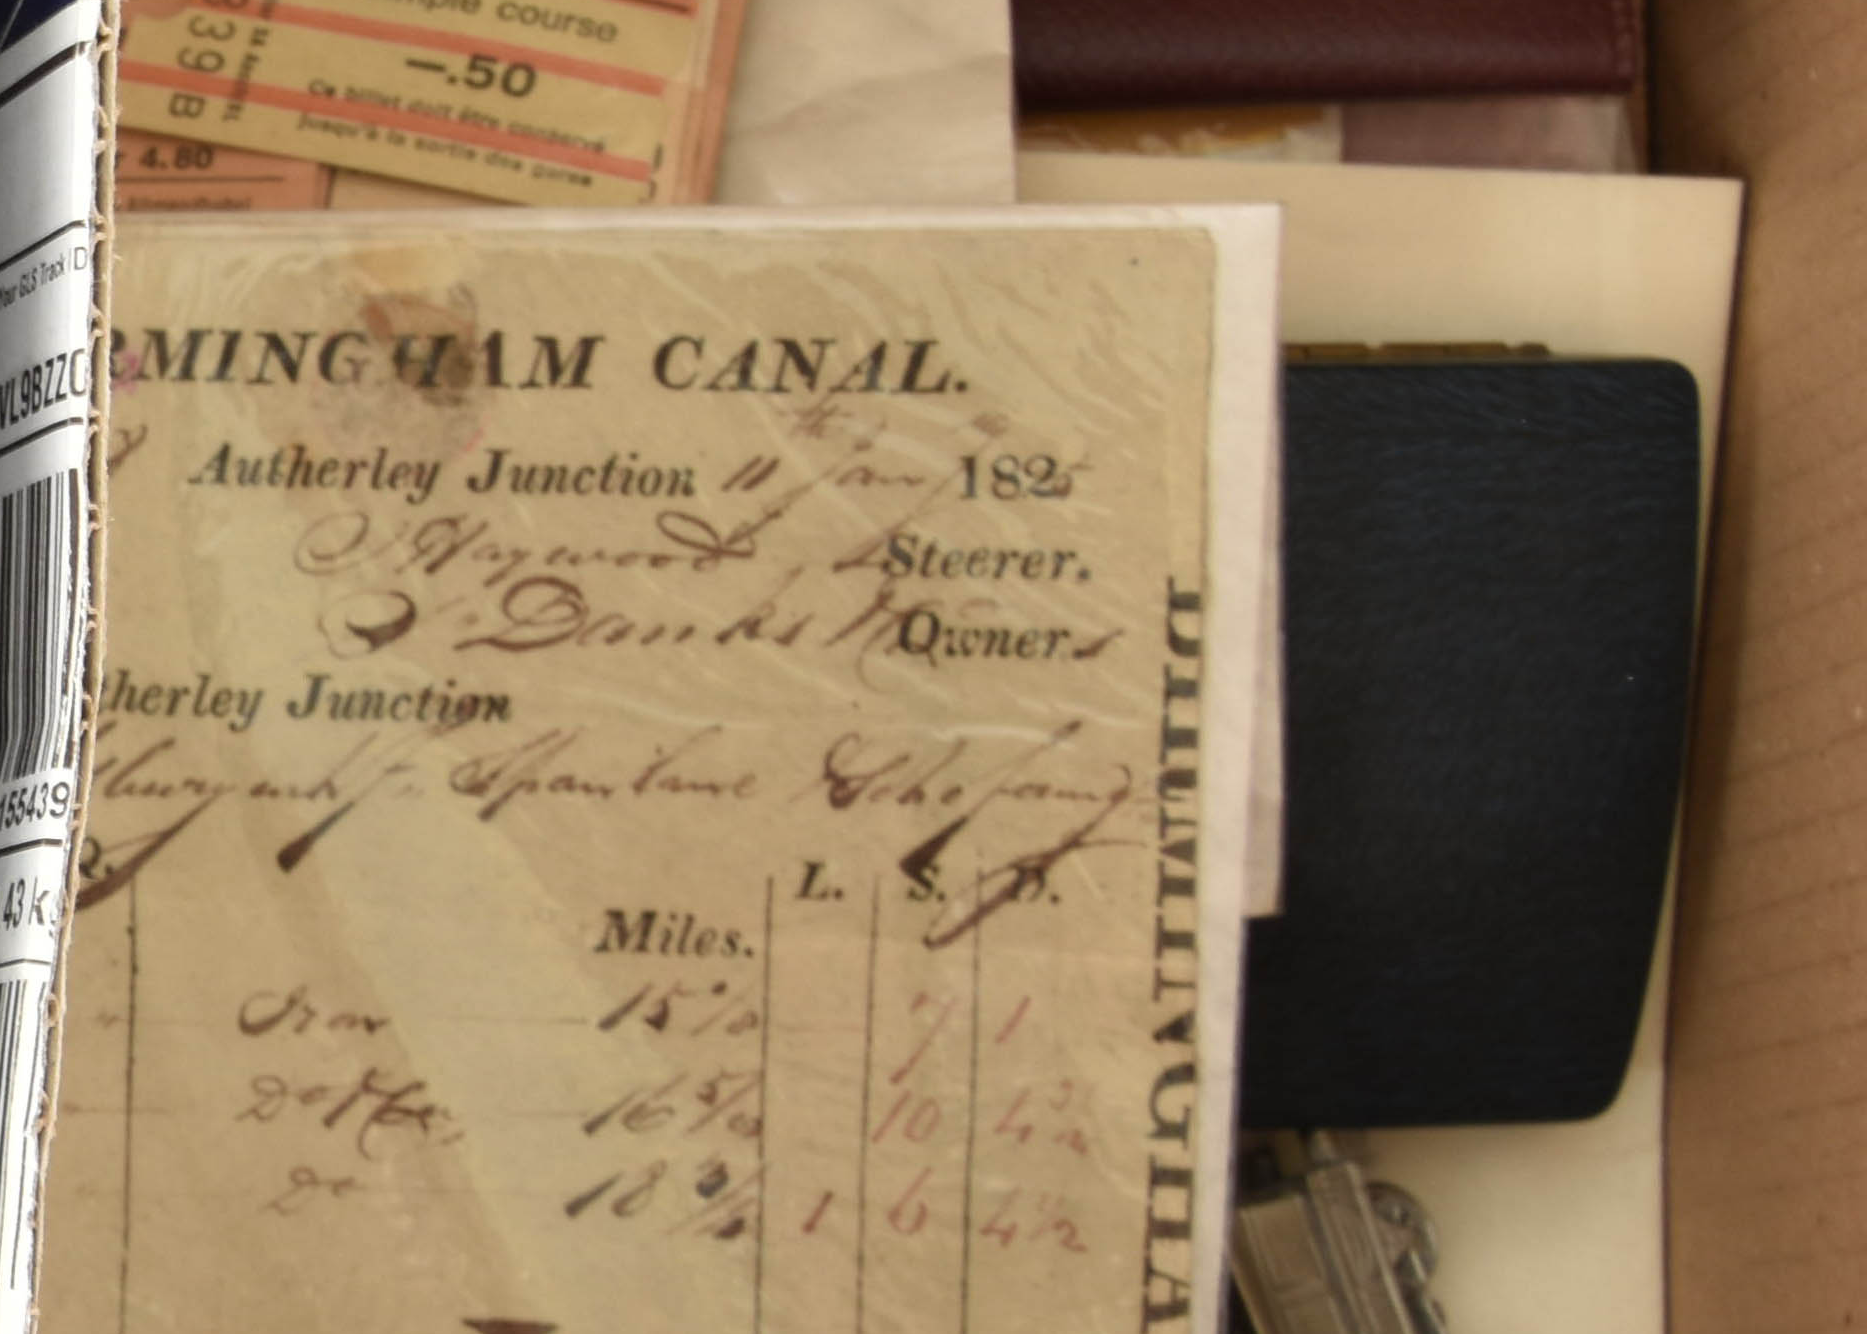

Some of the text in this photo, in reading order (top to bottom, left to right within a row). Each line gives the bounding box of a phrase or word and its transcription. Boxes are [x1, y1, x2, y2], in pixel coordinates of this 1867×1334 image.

[18, 267, 40, 299] GLS
[40, 253, 67, 289] Track
[652, 334, 970, 396] CANAL.
[188, 440, 698, 505] Autherley Junction
[880, 529, 1093, 582] Steerer.
[286, 672, 514, 725] Junction
[793, 860, 846, 903] L.
[593, 908, 757, 959] Miles.
